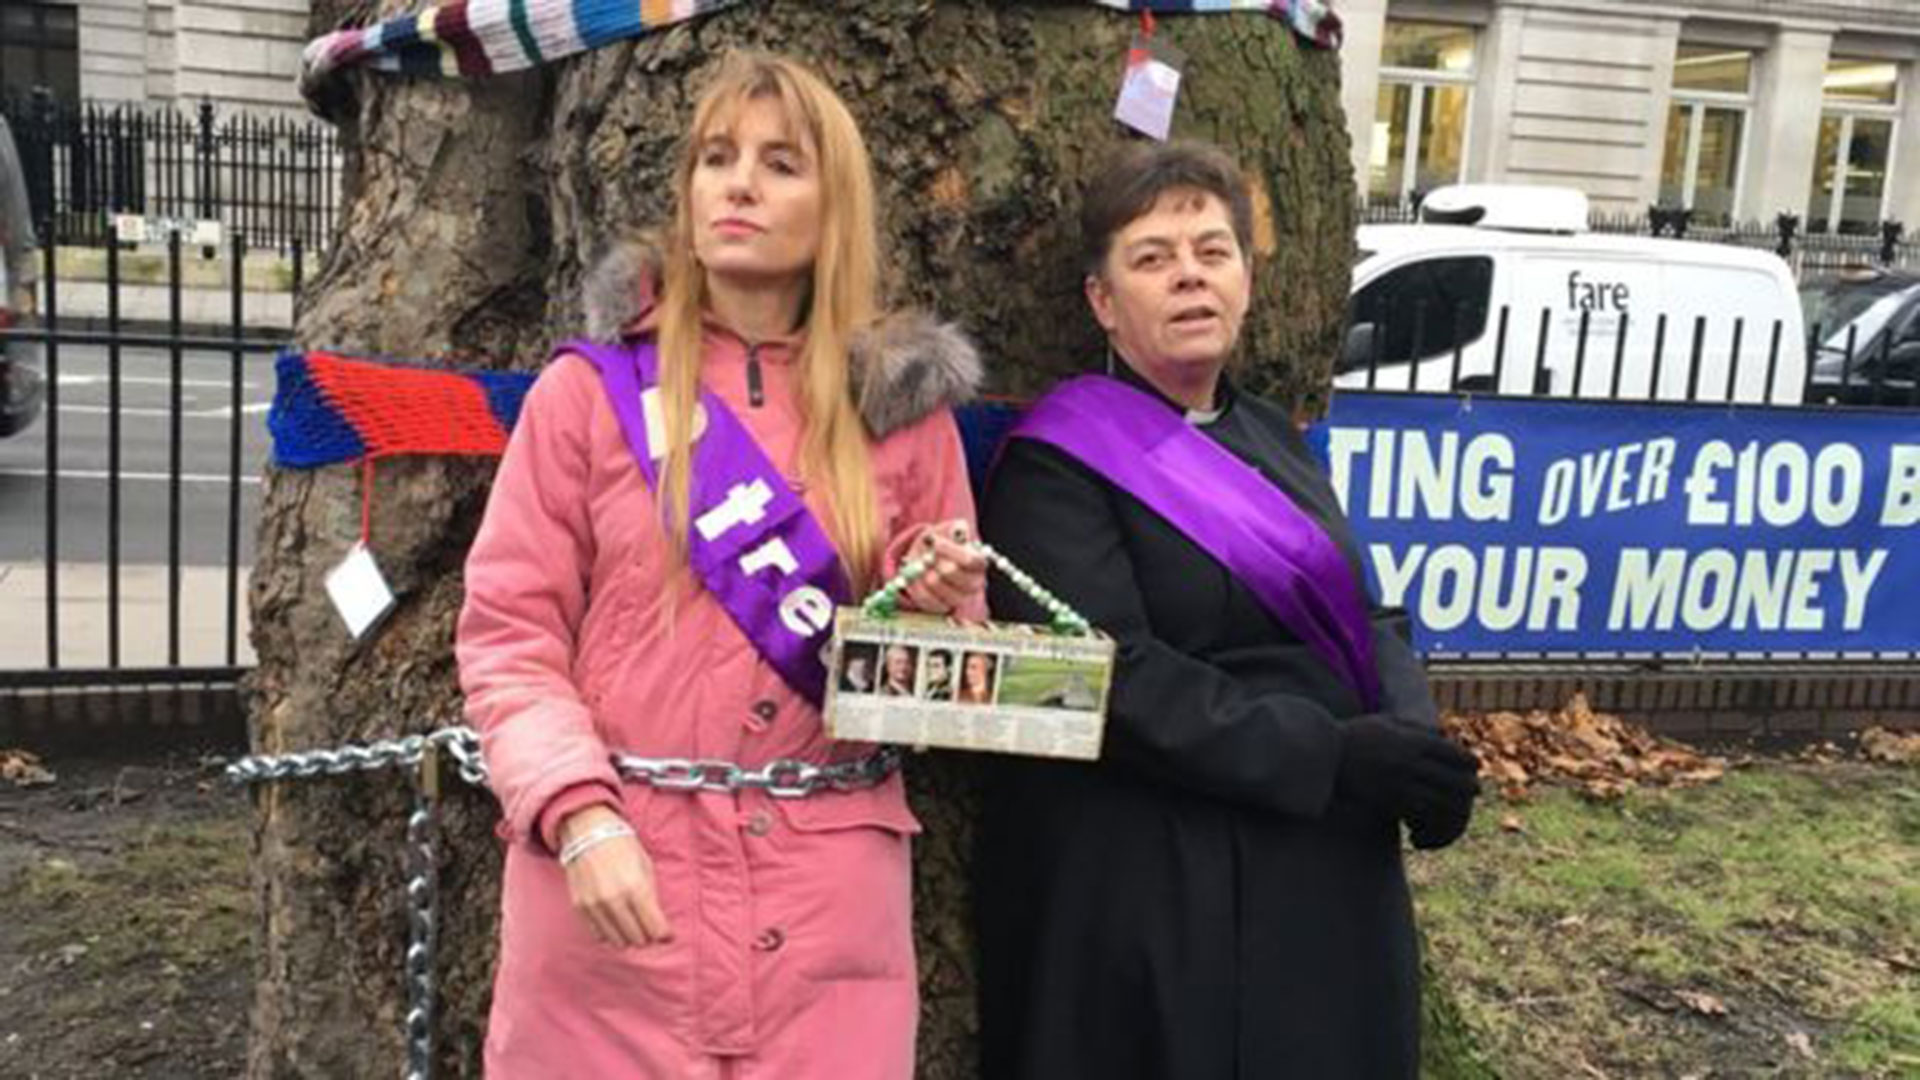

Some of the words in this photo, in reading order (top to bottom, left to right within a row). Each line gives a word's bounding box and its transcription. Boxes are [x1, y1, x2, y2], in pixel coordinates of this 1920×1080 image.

[1568, 269, 1629, 311] fare
[1328, 427, 1515, 521] TING
[1538, 436, 1677, 526] OVER
[1685, 440, 1864, 527] £100
[1879, 444, 1920, 527] B
[695, 477, 834, 668] tre
[1369, 543, 1589, 632] YOUR
[1607, 547, 1888, 632] MONEY
